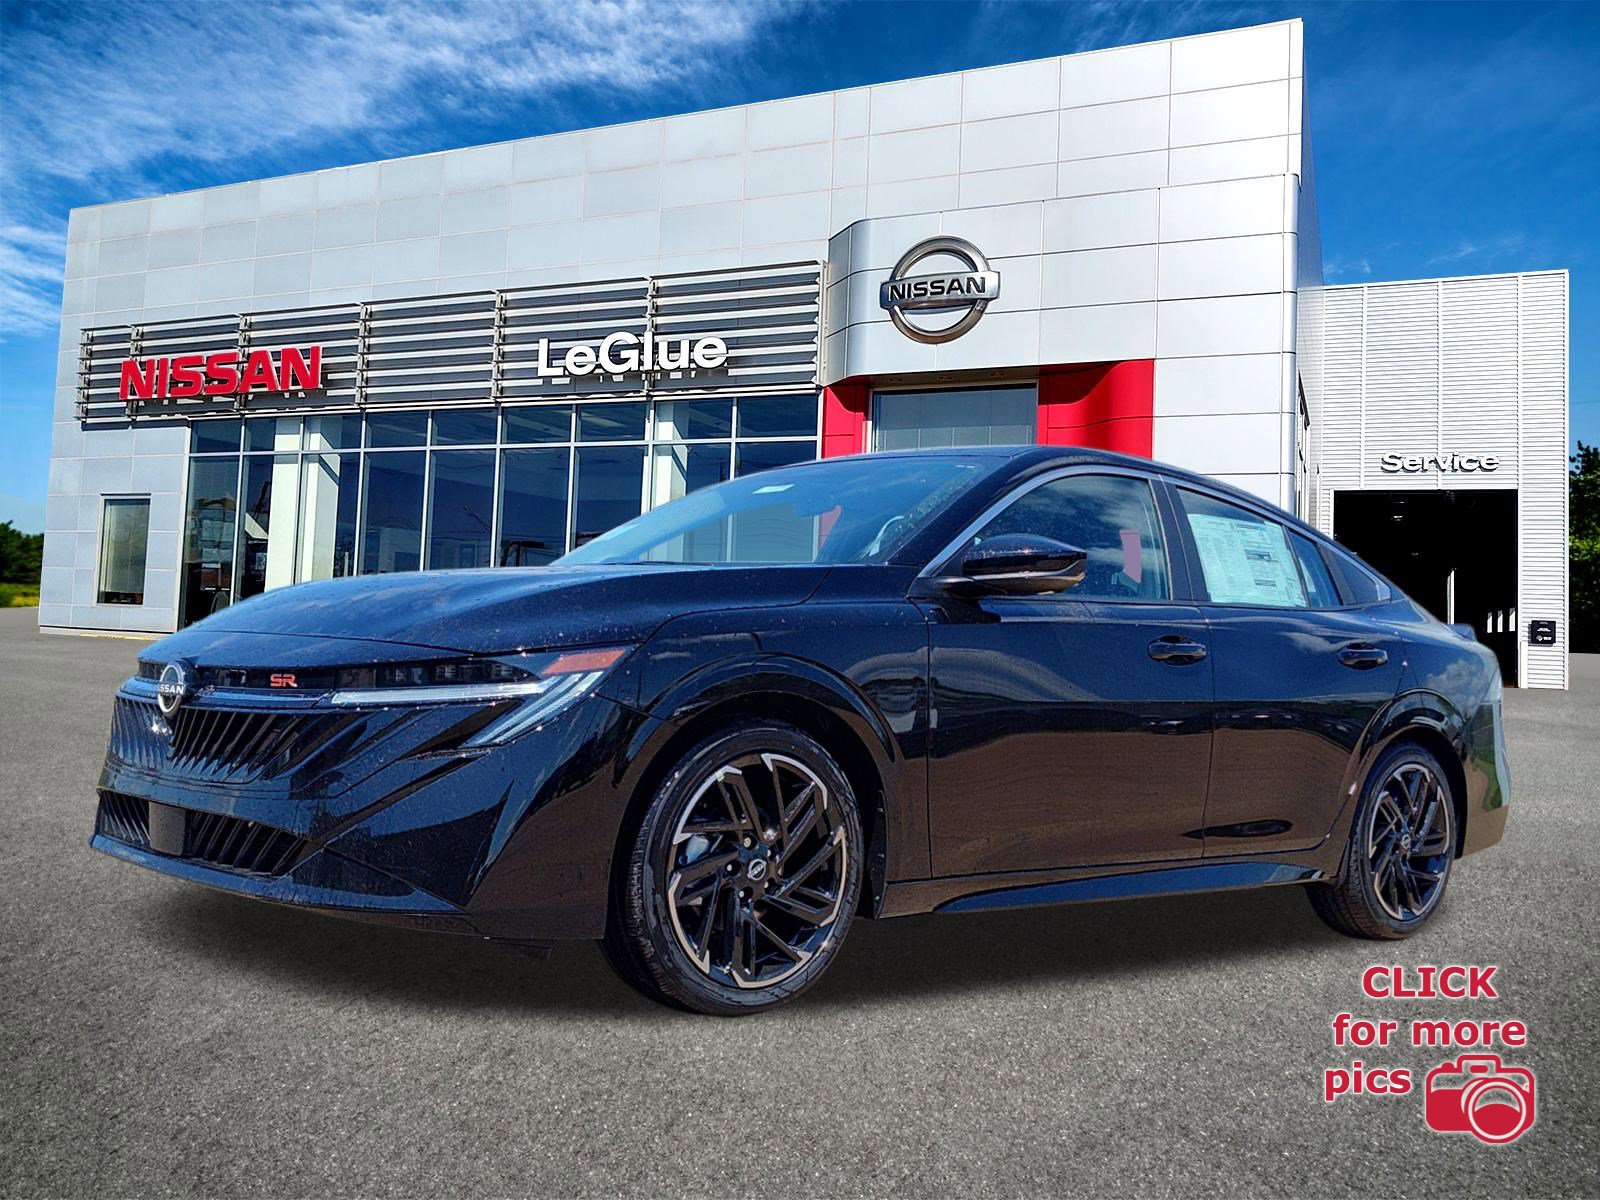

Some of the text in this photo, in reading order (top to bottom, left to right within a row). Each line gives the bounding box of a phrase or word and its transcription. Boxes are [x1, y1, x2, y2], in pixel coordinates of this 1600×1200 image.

[888, 276, 986, 301] NISSAN
[537, 331, 729, 377] LeGlue
[119, 346, 322, 400] NISSAN
[1381, 451, 1500, 473] Service
[270, 673, 298, 688] SR
